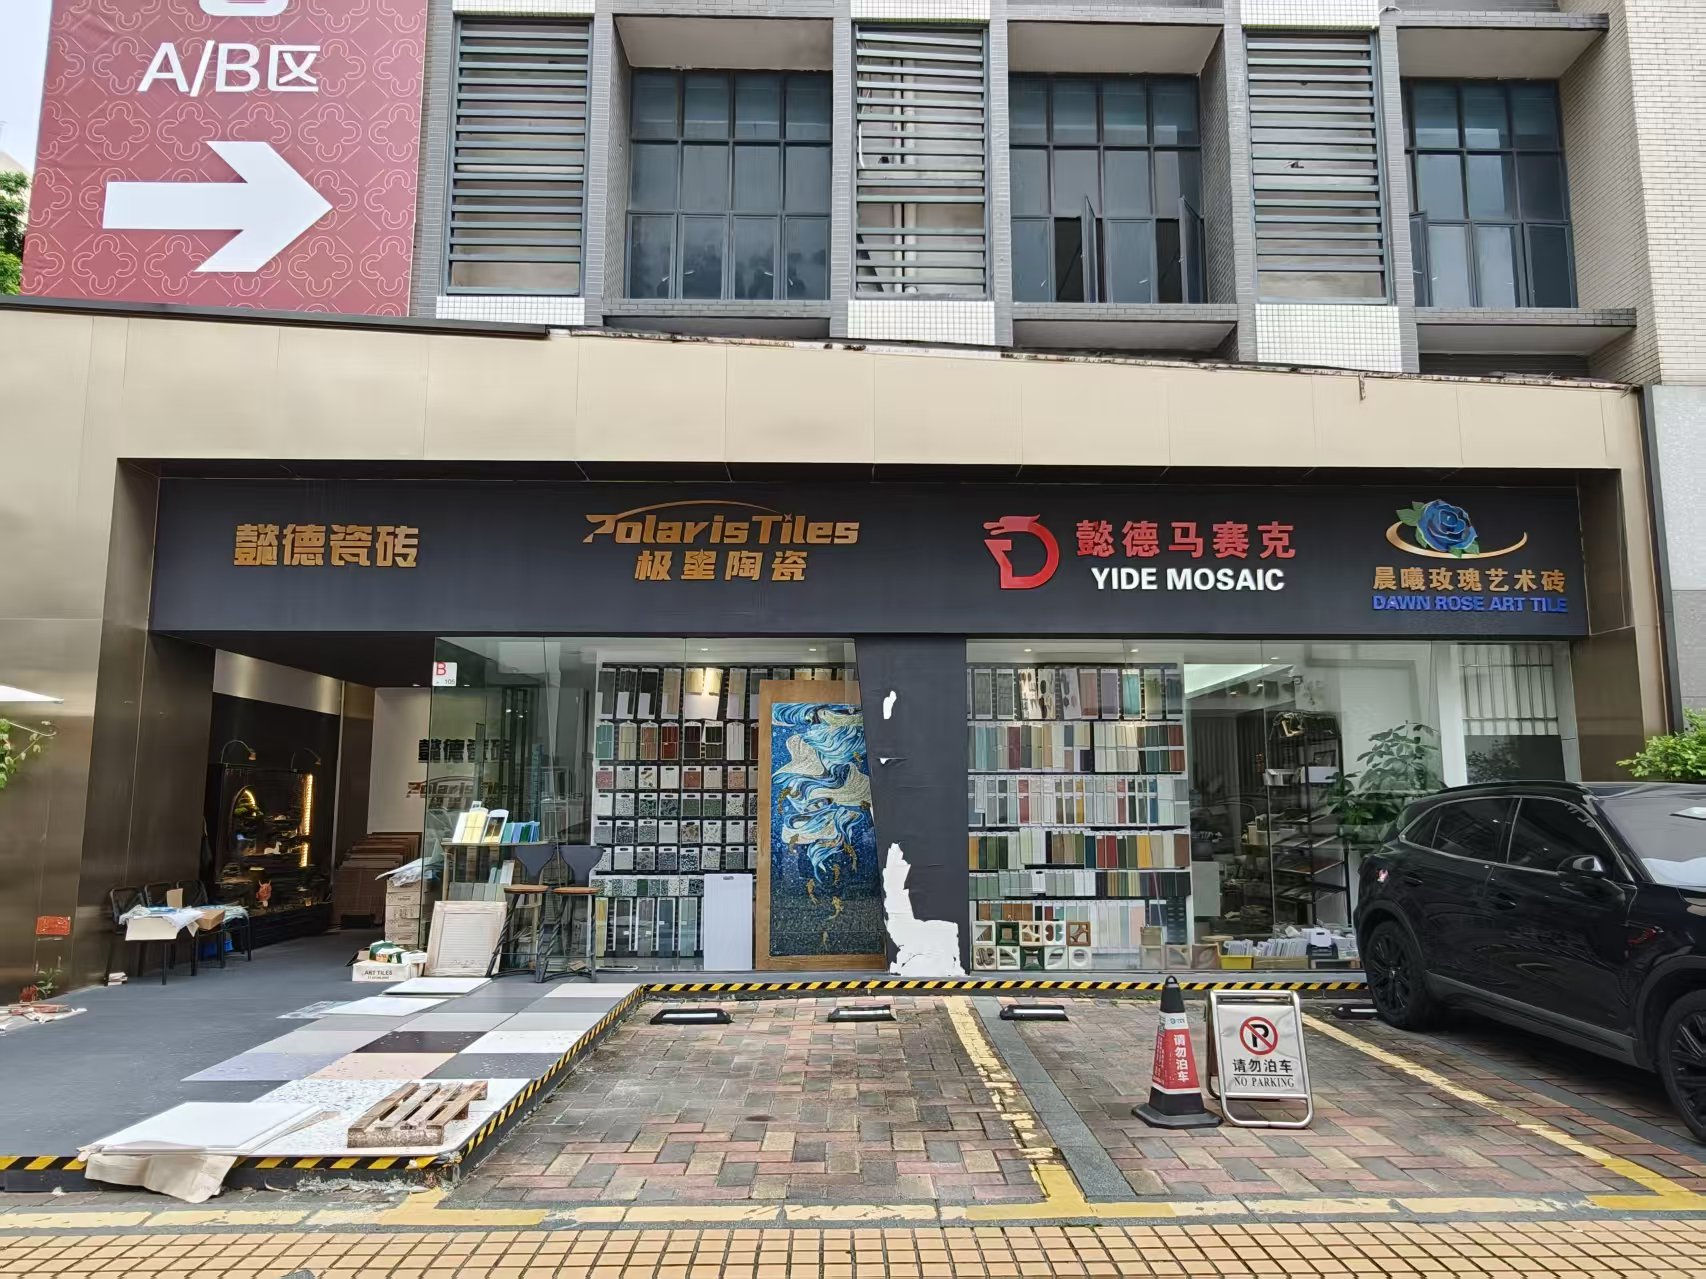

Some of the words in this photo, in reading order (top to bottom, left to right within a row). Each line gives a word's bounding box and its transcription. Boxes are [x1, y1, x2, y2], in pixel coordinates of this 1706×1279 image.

[137, 40, 320, 97] A/B区
[234, 523, 419, 568] 懿德瓷砖
[1075, 520, 1296, 559] 懿德马赛克
[634, 549, 807, 581] 极星陶瓷
[1091, 567, 1158, 590] YIDE
[1166, 567, 1286, 591] MOSAIC
[1373, 566, 1566, 593] 晨曦玫瑰艺术砖
[1372, 595, 1430, 611] DAWN
[1434, 596, 1485, 611] ROSE
[1489, 597, 1526, 611] ART
[1530, 597, 1569, 613] TILE
[436, 661, 447, 676] B
[1173, 1034, 1190, 1083] 请勿泊车
[1232, 1059, 1293, 1074] 请勿泊车
[1234, 1076, 1248, 1087] NO
[1251, 1076, 1295, 1088] PARKING
